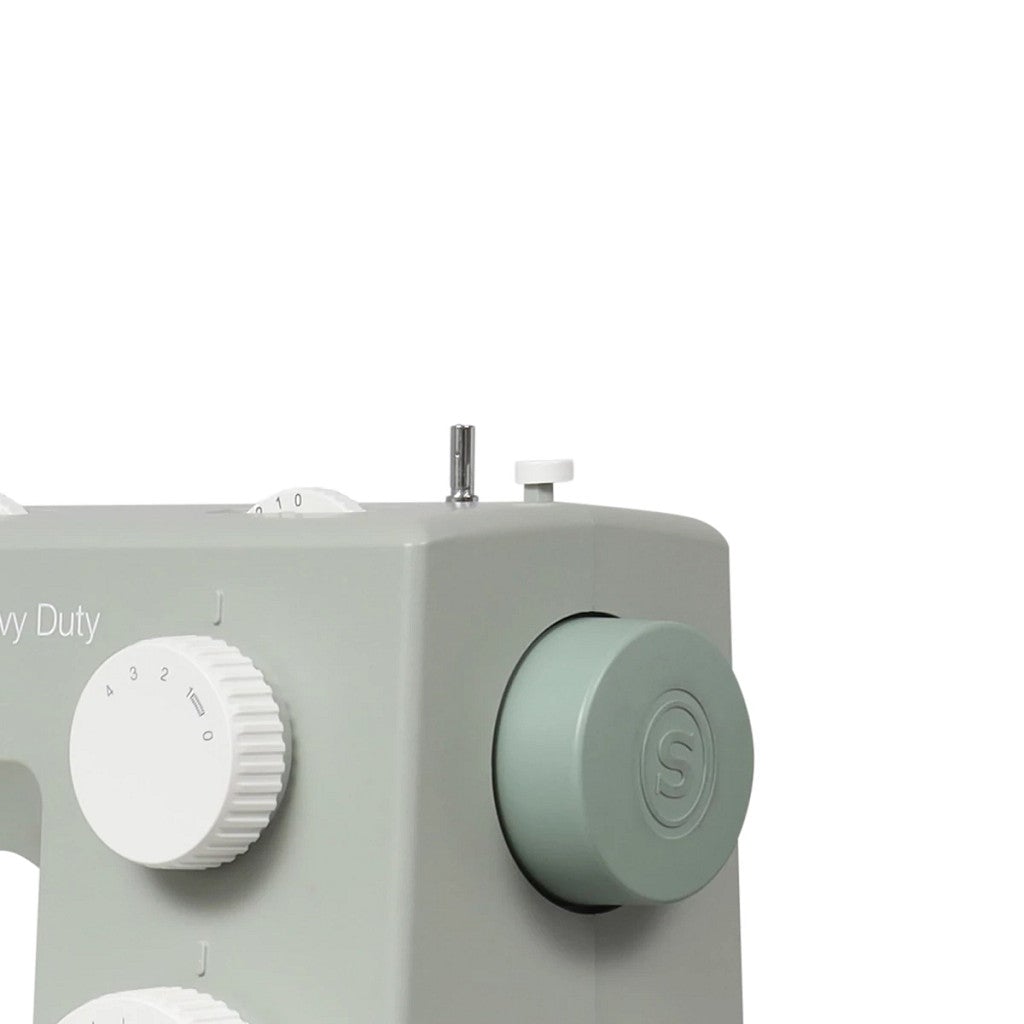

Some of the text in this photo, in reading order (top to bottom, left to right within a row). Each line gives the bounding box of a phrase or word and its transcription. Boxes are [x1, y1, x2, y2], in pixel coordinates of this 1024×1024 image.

[294, 493, 302, 507] 0
[36, 603, 101, 644] Duty
[106, 685, 114, 697] 4
[129, 666, 138, 681] 3
[160, 667, 169, 681] 2
